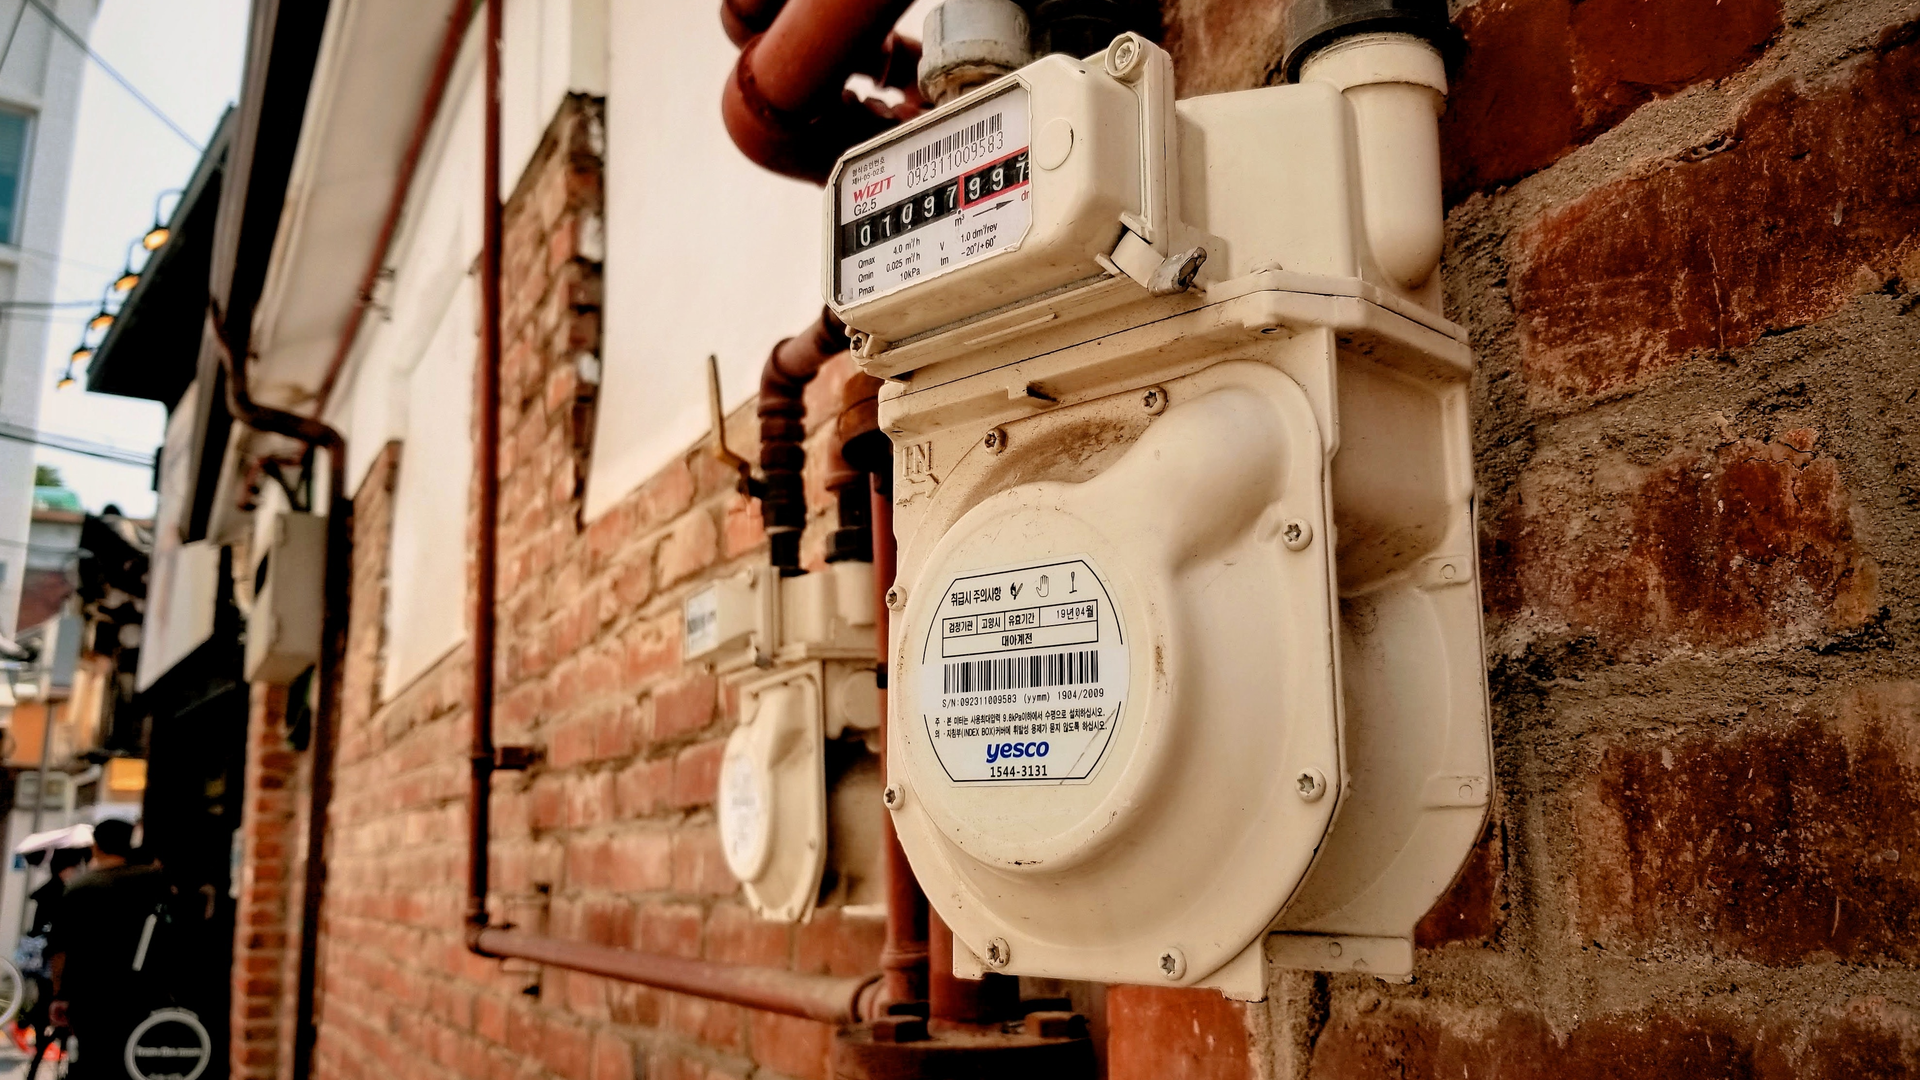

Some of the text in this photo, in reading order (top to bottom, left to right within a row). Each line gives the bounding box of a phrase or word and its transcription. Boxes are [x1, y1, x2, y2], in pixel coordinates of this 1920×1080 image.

[907, 131, 1003, 188] 092311009583
[853, 197, 877, 216] G2.5
[939, 241, 945, 251] V
[961, 231, 971, 243] 1.0
[857, 256, 876, 269] Qmax
[893, 244, 903, 255] 4.0
[857, 271, 874, 283] Qmin
[886, 259, 903, 273] 0.025
[858, 267, 921, 297] Pmax 10kPa
[903, 441, 932, 478] IN
[951, 586, 1002, 607] 취급시 주의사항
[949, 620, 973, 634] 검정기관
[981, 616, 1001, 630] 고양시
[1008, 612, 1035, 626] 유효기간
[1001, 632, 1033, 647] 대아계전
[1023, 692, 1051, 704] (yymm)
[1057, 688, 1105, 701] 1904/2009
[985, 740, 1050, 764] yesco
[989, 764, 1048, 778] 1544-3131
